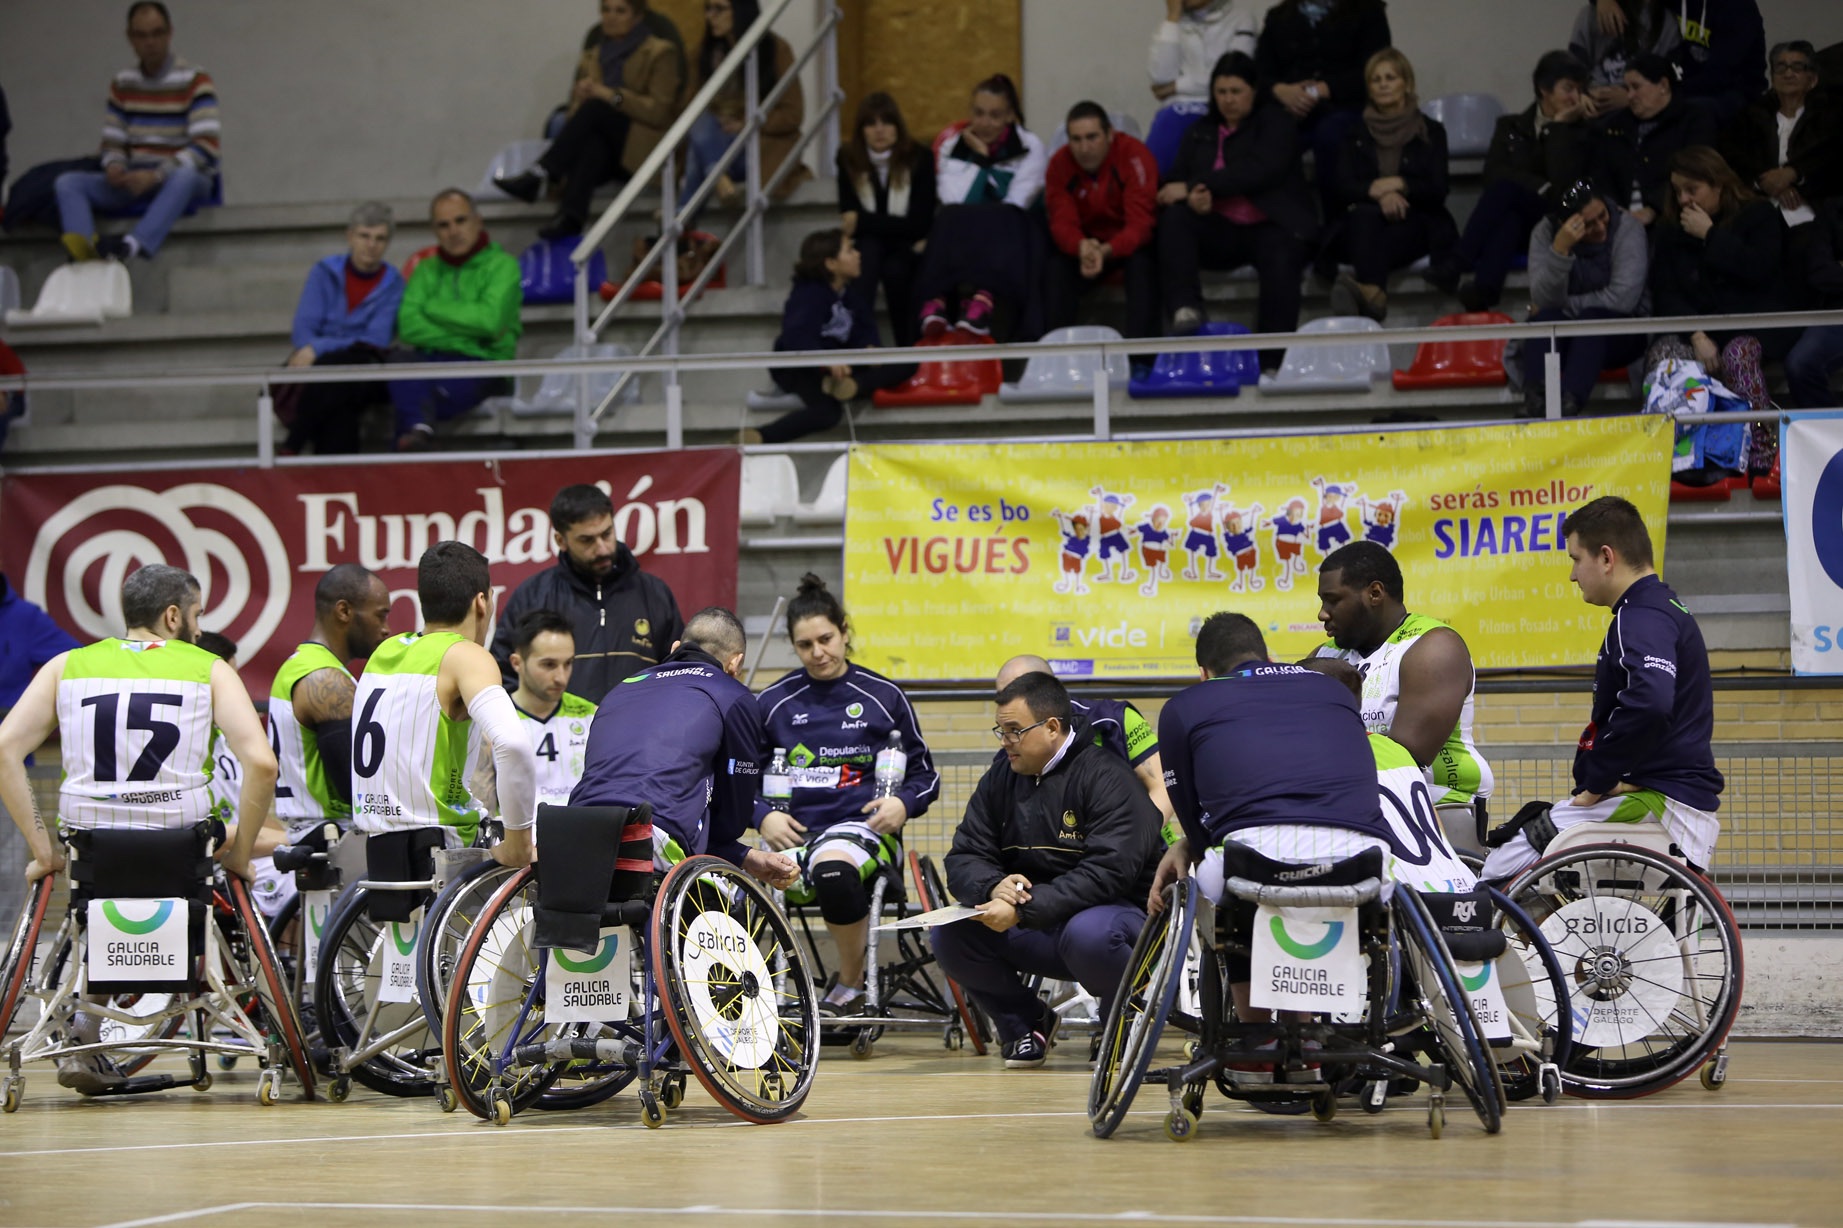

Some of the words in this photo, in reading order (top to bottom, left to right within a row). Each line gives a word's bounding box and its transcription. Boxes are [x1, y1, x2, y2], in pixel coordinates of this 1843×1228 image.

[1430, 482, 1499, 511] serás
[1510, 479, 1594, 506] mellor
[931, 497, 958, 522] Se
[968, 504, 992, 522] es
[1000, 497, 1030, 522] bo
[297, 474, 710, 573] Fundaón
[1433, 511, 1576, 559] SIAREI
[884, 525, 1030, 575] VIGUÉS
[1077, 620, 1148, 648] vide
[81, 692, 184, 782] 15
[353, 687, 387, 779] 6
[535, 732, 560, 762] 4
[819, 745, 871, 758] Deputación
[805, 774, 829, 785] VIGO
[122, 789, 183, 805] SAUDABLE
[540, 785, 573, 800] Deput
[1278, 862, 1335, 882] QUICKIE
[1552, 911, 1649, 944] galicia
[107, 941, 160, 954] GALICIA
[690, 927, 747, 959] galicia
[107, 954, 175, 967] SAUDABLE
[1272, 965, 1328, 982] GALICIA
[563, 980, 610, 994] GALICIA
[1271, 979, 1345, 997] SAUDABLE
[563, 992, 622, 1008] SAUDABLE
[1472, 998, 1488, 1011] CIA
[1477, 1010, 1500, 1023] ABLE
[1593, 1007, 1639, 1016] DEPORTE
[1593, 1016, 1634, 1024] GALEGO
